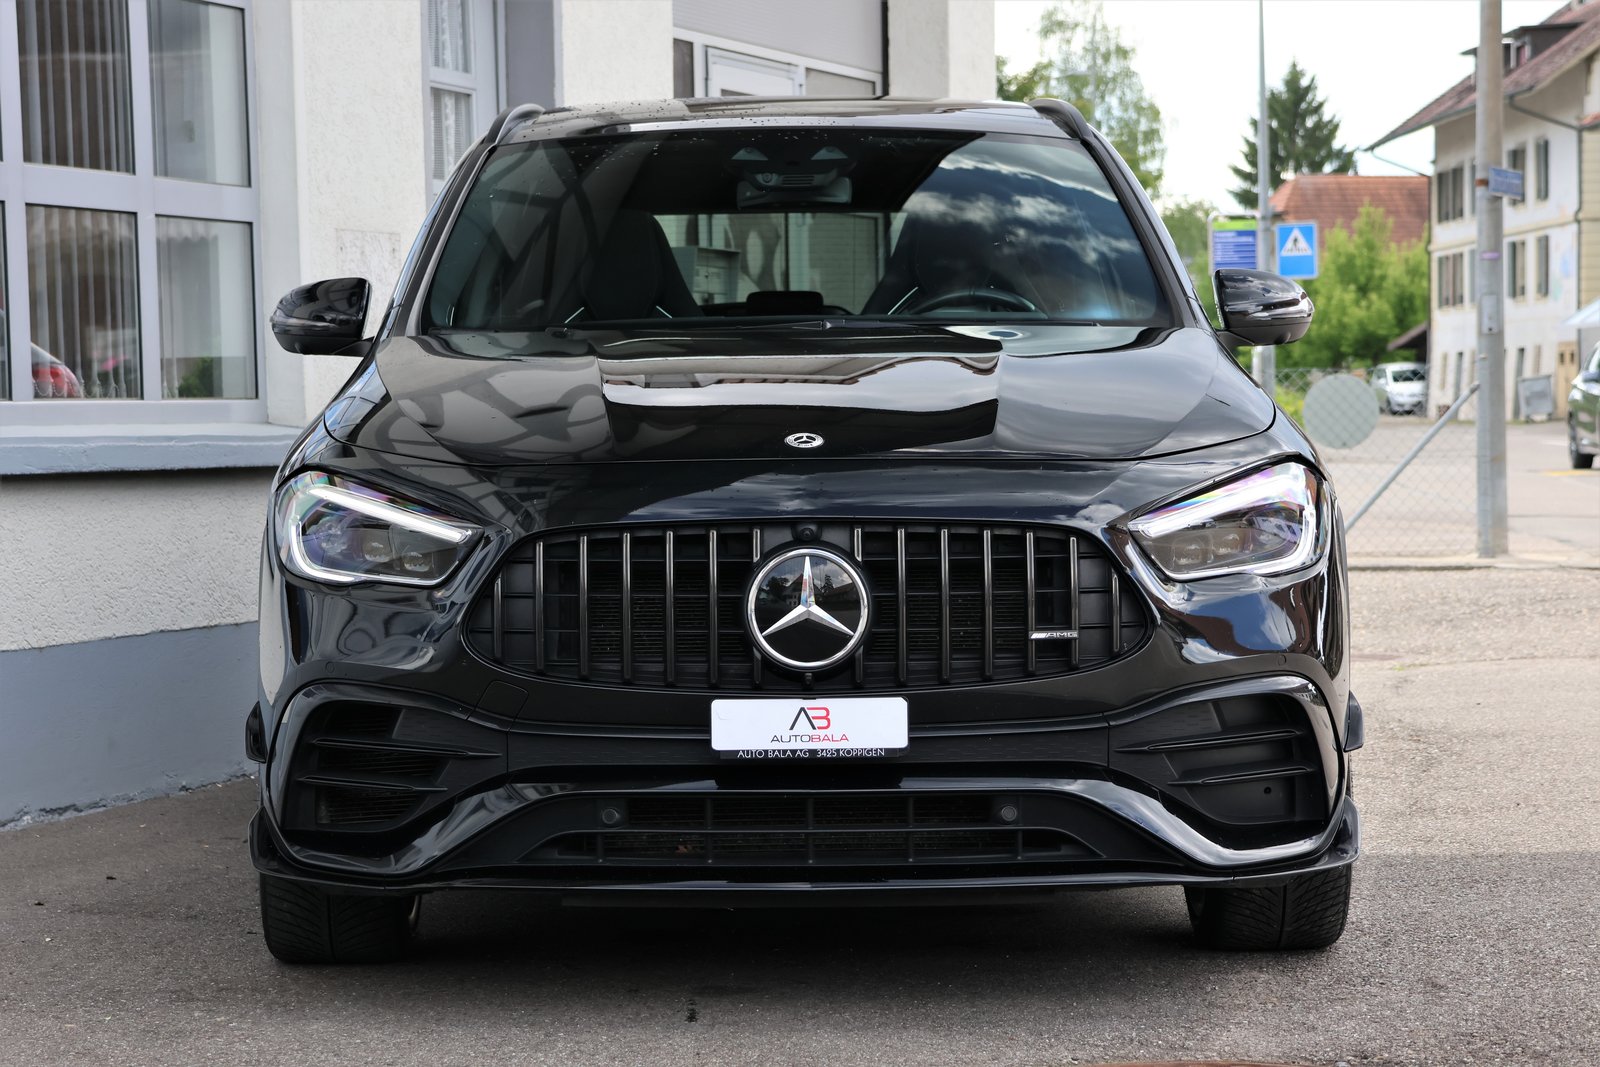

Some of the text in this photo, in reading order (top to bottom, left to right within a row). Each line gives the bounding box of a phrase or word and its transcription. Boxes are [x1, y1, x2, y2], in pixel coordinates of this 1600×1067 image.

[770, 733, 849, 743] AUTOBALA
[737, 747, 885, 758] AUTO BALA AG 3425 KOPPIGEN
